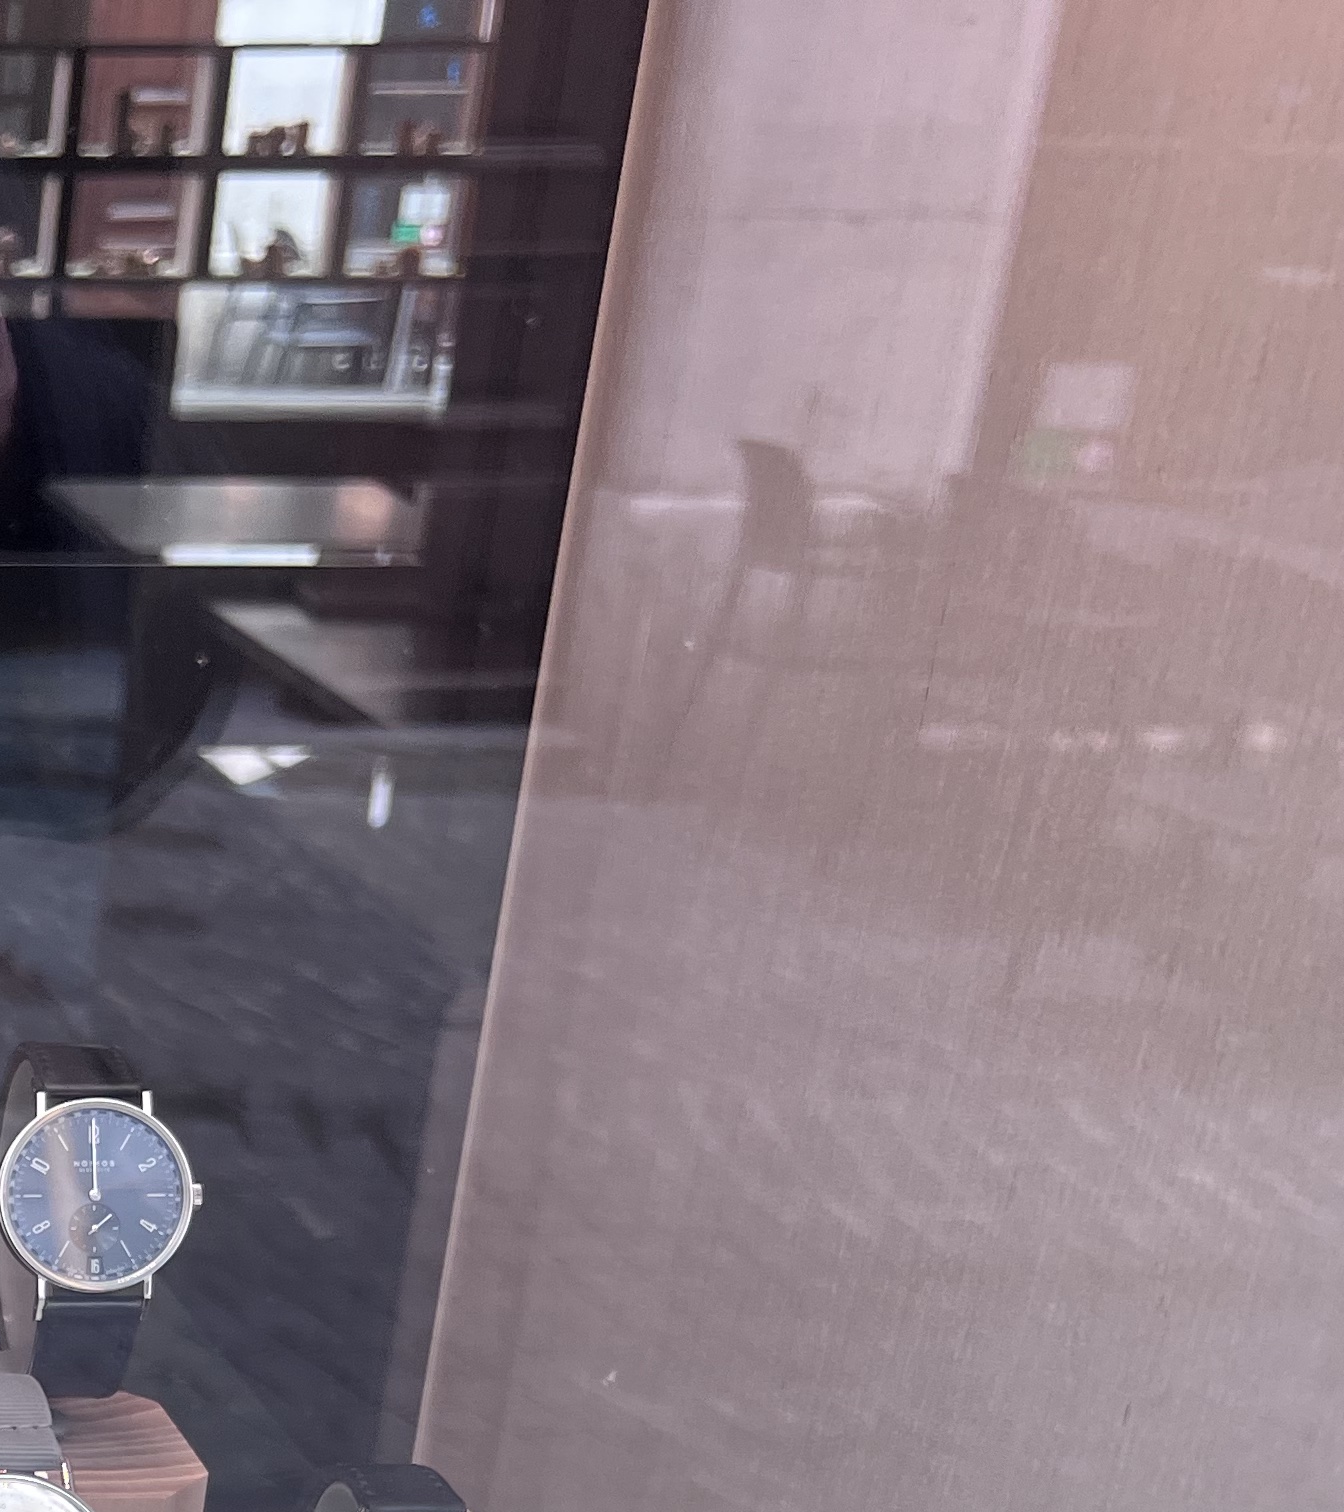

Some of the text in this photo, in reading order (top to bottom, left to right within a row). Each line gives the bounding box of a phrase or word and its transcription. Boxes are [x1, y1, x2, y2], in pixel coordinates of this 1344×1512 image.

[30, 1157, 50, 1175] 10
[138, 1158, 157, 1173] 2
[32, 1220, 51, 1234] 8
[140, 1219, 157, 1233] 4
[90, 1258, 100, 1274] 16
